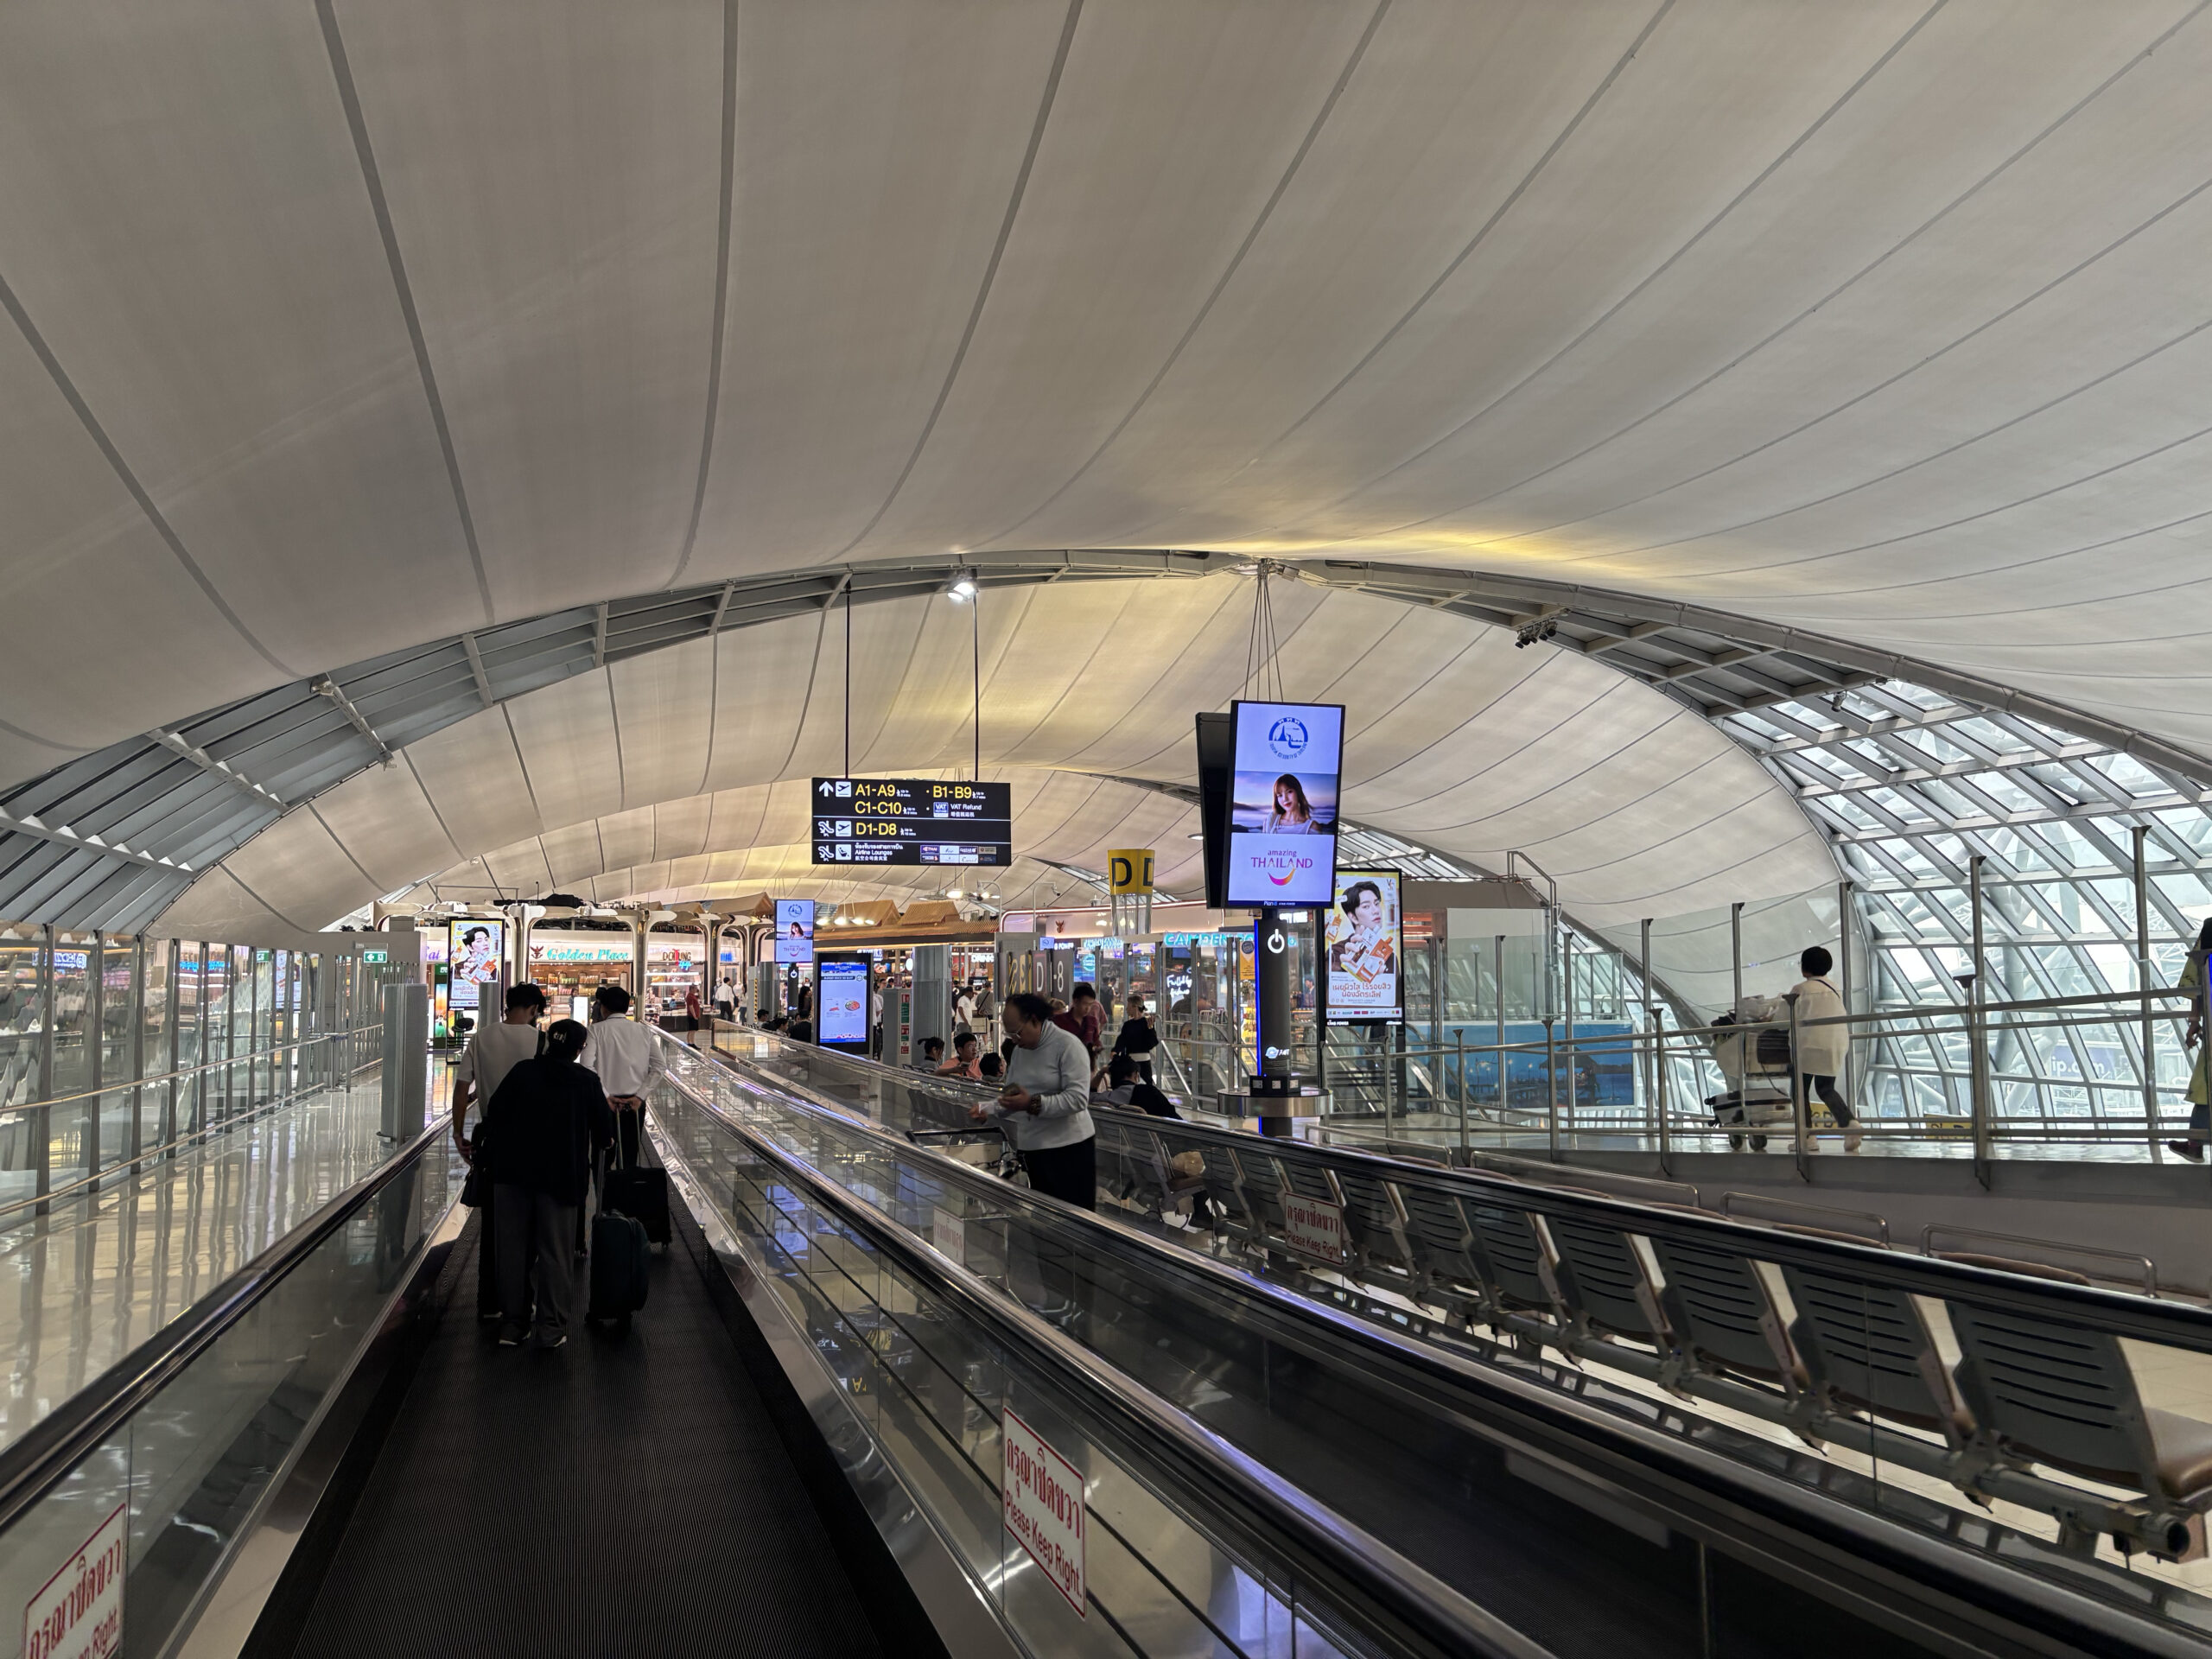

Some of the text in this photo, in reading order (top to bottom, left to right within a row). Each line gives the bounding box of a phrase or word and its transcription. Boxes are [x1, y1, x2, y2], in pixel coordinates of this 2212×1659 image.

[855, 784, 895, 797] A1-A9
[933, 785, 972, 798] B1-B9
[855, 801, 902, 815] C1-C10
[856, 823, 897, 836] D1-D8
[1111, 857, 1132, 887] D
[1251, 857, 1313, 868] THAILAND
[547, 949, 628, 960] Golden Place
[1036, 962, 1044, 992] D
[1287, 1202, 1338, 1234] กรุณาชิดขวา
[1287, 1230, 1306, 1247] Please
[1306, 1236, 1321, 1254] Keep
[1007, 1438, 1081, 1539] กรุณาชิดขวา
[1006, 1490, 1082, 1599] Please Keep Right.
[30, 1539, 121, 1659] กรณาชิดขวา
